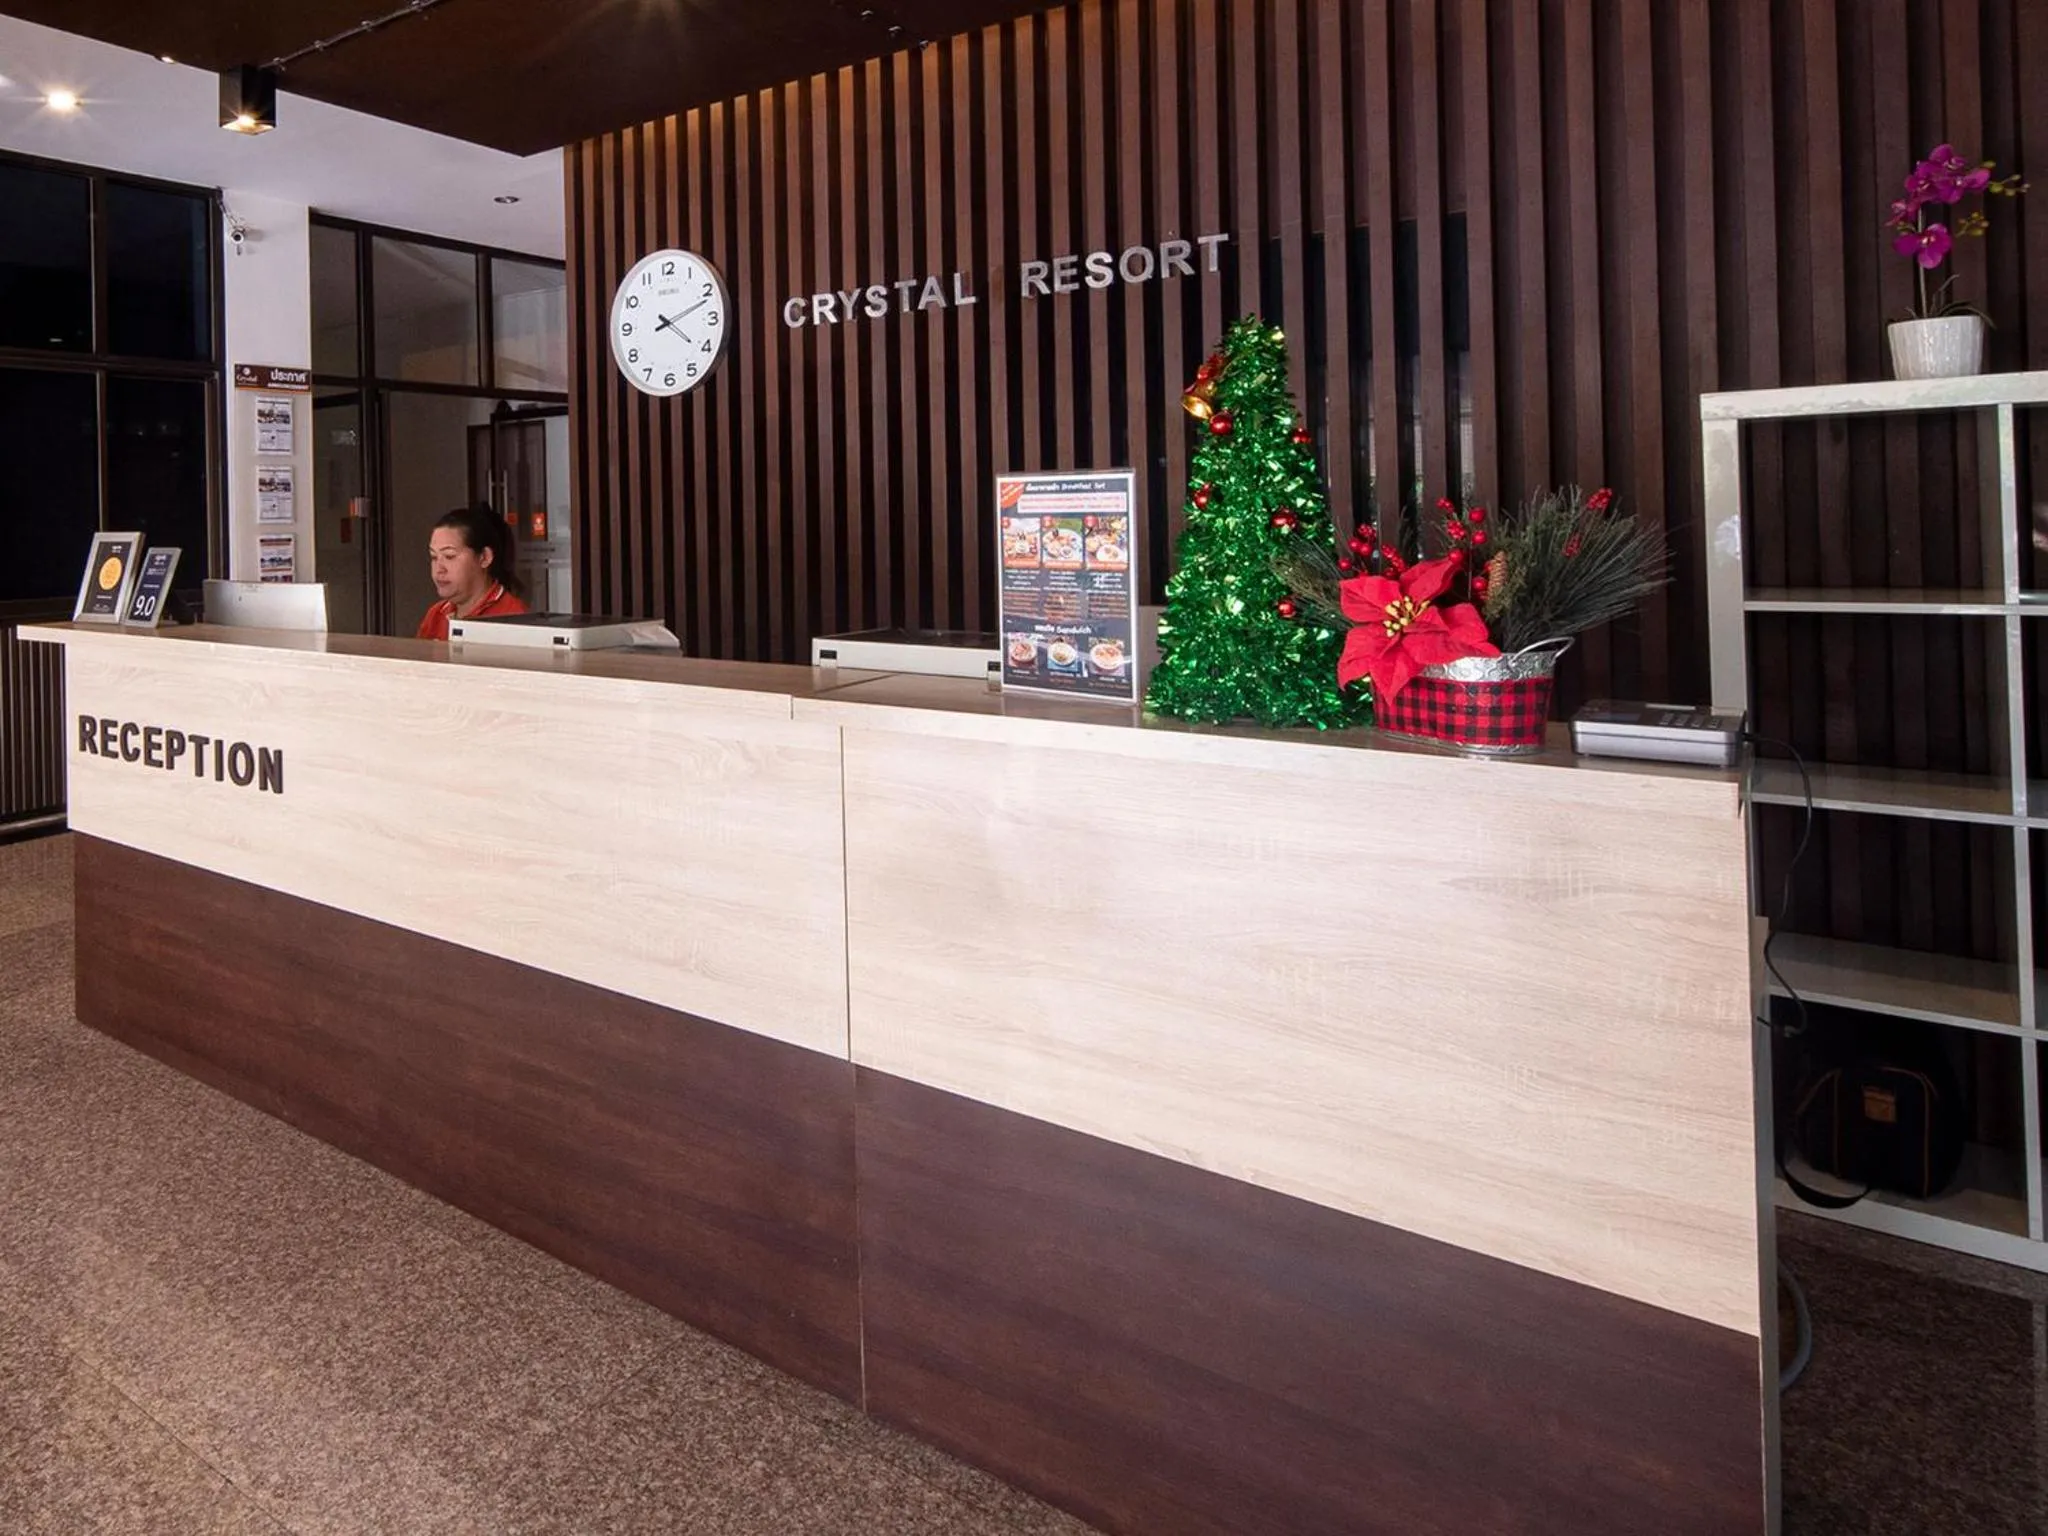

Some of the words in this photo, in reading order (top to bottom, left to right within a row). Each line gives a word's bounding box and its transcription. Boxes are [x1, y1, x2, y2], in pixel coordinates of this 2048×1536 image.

[661, 261, 675, 276] 12
[688, 267, 692, 280] 1
[642, 272, 652, 286] 11
[783, 272, 977, 329] CRYSTAL
[1020, 233, 1230, 299] RESORT
[702, 283, 713, 297] 2
[626, 295, 639, 309] 10
[707, 311, 719, 326] 3
[621, 322, 633, 337] 9
[701, 339, 712, 353] 4
[628, 349, 639, 363] 8
[270, 368, 308, 382] ประกาศ
[642, 367, 653, 382] 7
[686, 362, 698, 377] 5
[664, 373, 677, 387] 6
[133, 595, 156, 616] 9.0
[78, 714, 284, 794] RECEPTION
